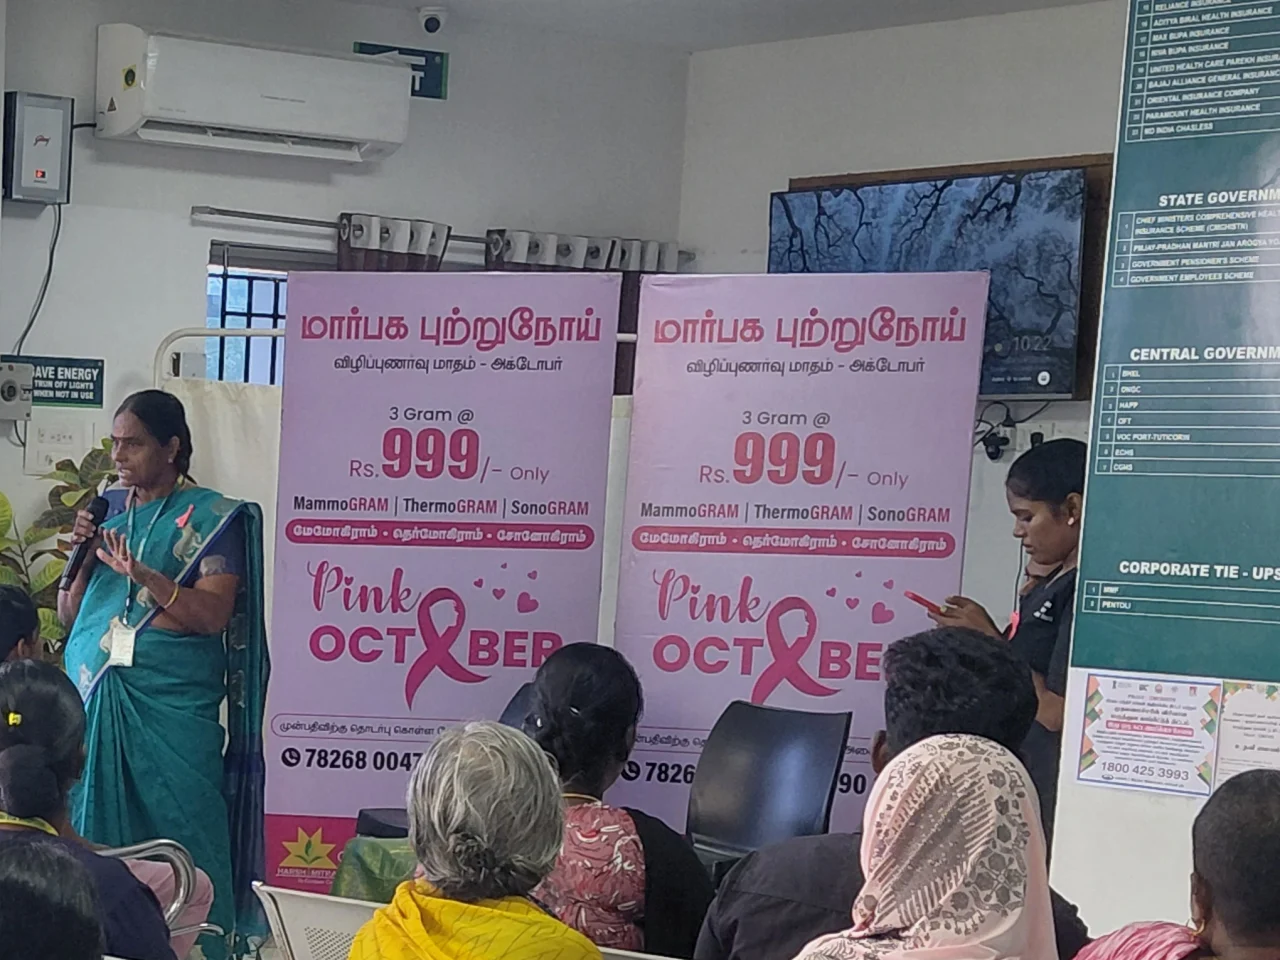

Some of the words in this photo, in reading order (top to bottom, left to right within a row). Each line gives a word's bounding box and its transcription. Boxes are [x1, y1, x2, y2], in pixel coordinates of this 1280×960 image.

[1201, 11, 1230, 21] HEALTH
[1231, 6, 1273, 18] INSURANCE
[1152, 33, 1168, 41] MAX
[1169, 31, 1188, 40] BUPA
[1189, 26, 1230, 38] INSURANCE
[1168, 46, 1187, 55] BUPA
[1188, 41, 1230, 53] INSURANCE
[1149, 64, 1175, 74] UNITED
[1176, 61, 1204, 71] HEALTH
[1204, 59, 1225, 68] CARE
[1148, 79, 1171, 89] BAJAJ
[1171, 76, 1207, 86] ALLIANCE
[1207, 73, 1242, 83] GENERAL
[1147, 95, 1181, 104] ORIENTAL
[1182, 90, 1223, 101] INSURANCE
[1224, 87, 1260, 97] COMPANY
[1145, 110, 1189, 120] PARAMOUNT
[1190, 107, 1218, 116] HEALTH
[1219, 102, 1261, 114] INSURANCE
[1156, 126, 1174, 134] INDIA
[1158, 193, 1204, 207] STATE
[1195, 211, 1257, 221] COMPREHENSIVE
[1135, 226, 1174, 235] INSURANCE
[1176, 225, 1205, 233] SCHEME
[1221, 240, 1236, 248] JAN
[1132, 259, 1180, 268] GOVERNMENT
[1229, 255, 1260, 264] SCHEME
[1130, 274, 1179, 283] GOVERNMENT
[1179, 273, 1222, 281] EMPLOYEES
[1224, 271, 1255, 280] SCHEME
[301, 306, 409, 341] மார்பக
[421, 306, 601, 351] புற்றுநோய்
[654, 308, 765, 343] மார்பக
[777, 306, 966, 352] புற்றுநோய்
[1130, 347, 1199, 361] CENTRAL
[1204, 345, 1280, 360] GOVERNM
[33, 365, 55, 379] AVE
[57, 366, 99, 381] ENERGY
[433, 356, 476, 375] மாதம்
[491, 355, 563, 371] அக்டோபர்
[789, 358, 834, 377] மாதம்
[848, 357, 925, 373] அக்டோபர்
[54, 381, 68, 389] OFF
[69, 382, 94, 390] LIGHTS
[1120, 385, 1141, 393] ONGC
[70, 391, 79, 399] IN
[80, 392, 94, 400] USE
[389, 406, 399, 421] 3
[403, 406, 452, 422] Gram
[457, 408, 474, 424] @
[742, 411, 752, 425] 3
[757, 411, 807, 426] Gram
[813, 412, 831, 427] @
[1117, 417, 1132, 425] OFT
[1116, 433, 1131, 441] VOC
[510, 466, 550, 484] Only
[867, 471, 909, 490] Only
[293, 496, 388, 513] MammoGRAM
[403, 498, 498, 514] ThermoGRAM
[511, 500, 590, 516] SonoGRAM
[640, 502, 739, 519] MammoGRAM
[754, 504, 853, 520] ThermoGRAM
[867, 506, 951, 523] SonoGRAM
[1119, 561, 1210, 577] CORPORATE
[1214, 565, 1239, 579] TIE
[1252, 566, 1280, 581] UPS
[307, 560, 422, 613] Pink
[652, 568, 772, 623] Pink
[305, 748, 367, 769] 78268
[373, 751, 424, 772] 0047
[645, 761, 696, 784] 7826
[1101, 761, 1129, 773] 1800
[1132, 765, 1155, 776] 425
[1158, 767, 1189, 780] 3993
